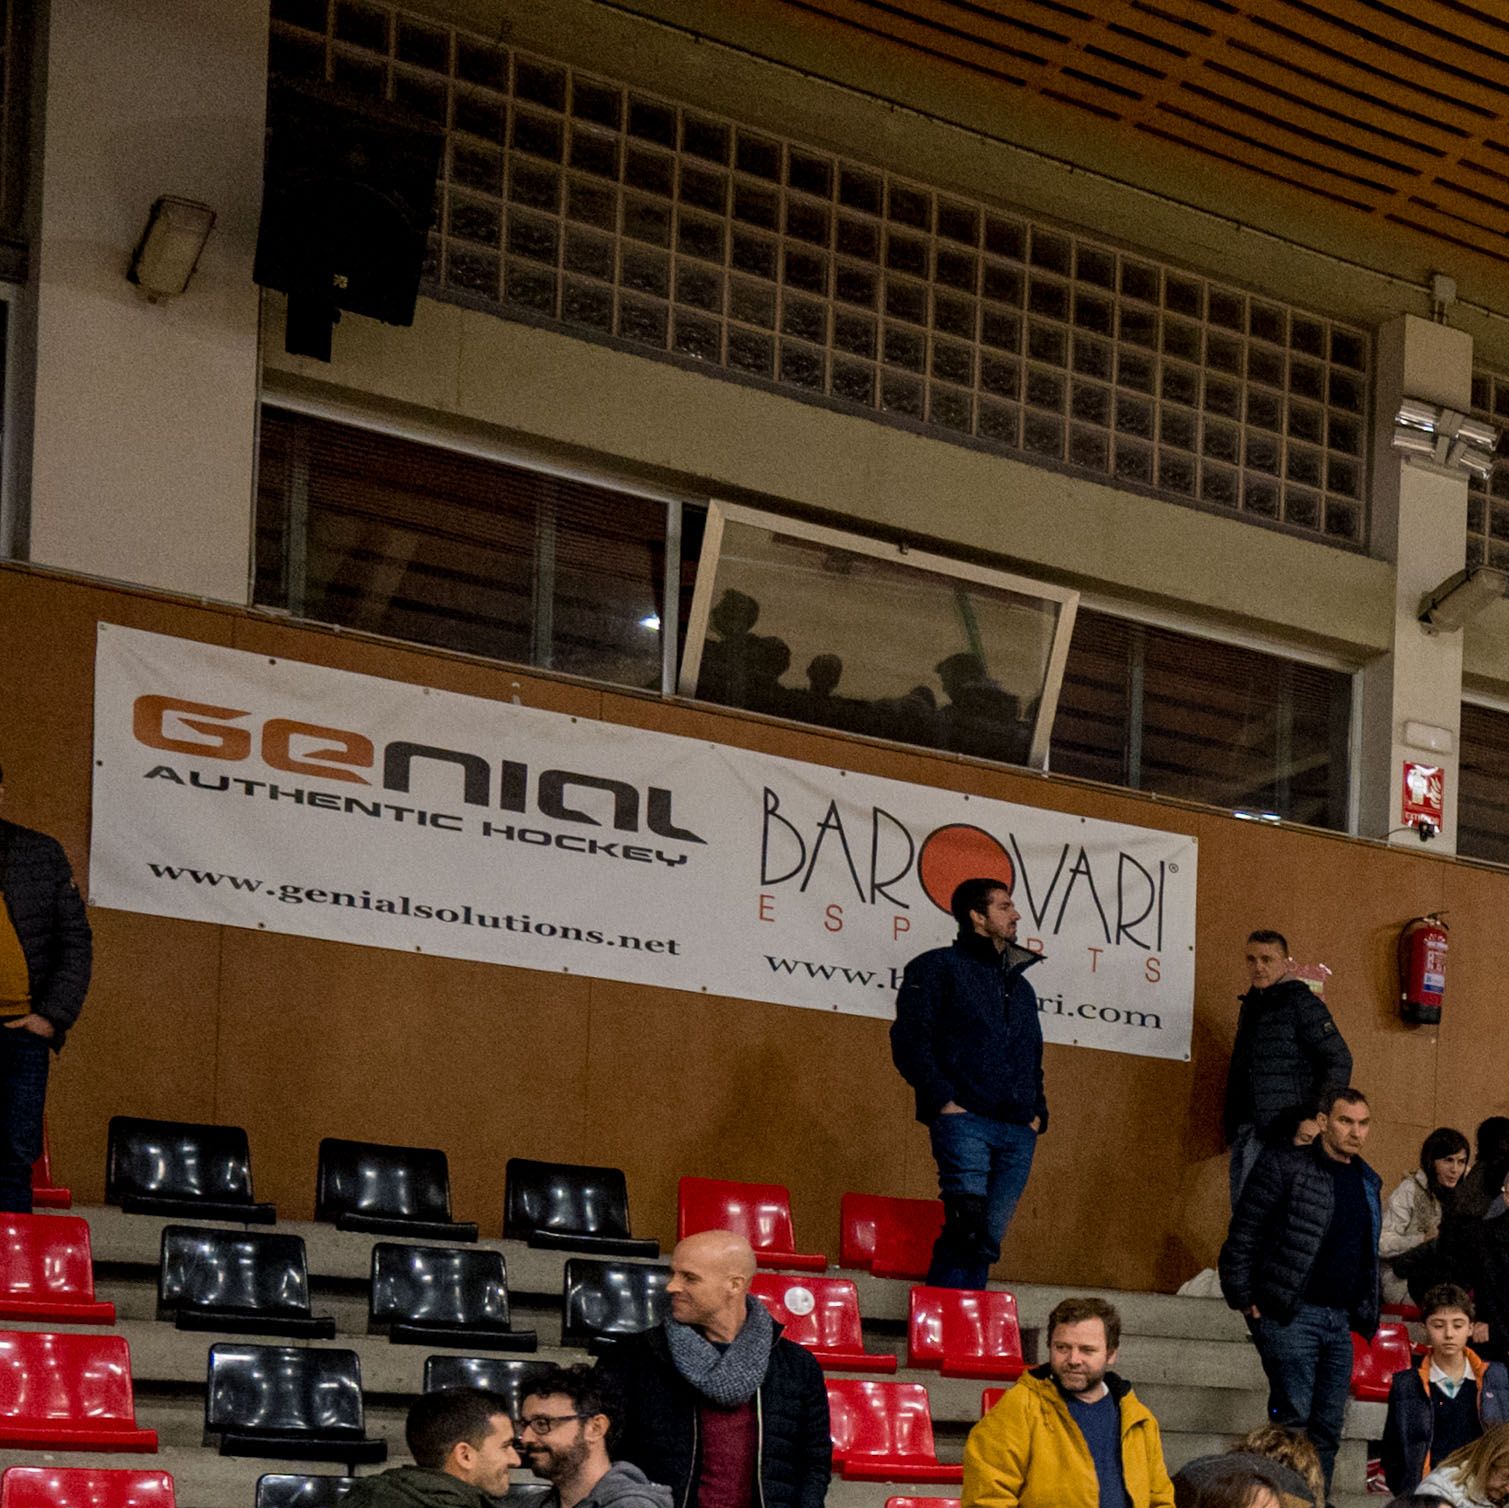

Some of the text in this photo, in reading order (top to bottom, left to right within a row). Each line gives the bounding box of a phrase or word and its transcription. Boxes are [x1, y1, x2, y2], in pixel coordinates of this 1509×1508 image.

[143, 765, 688, 868] AUTHENTIC HOCKEY
[147, 861, 681, 957] www.genialsolutions.net
[759, 893, 1162, 984] ESPRTS
